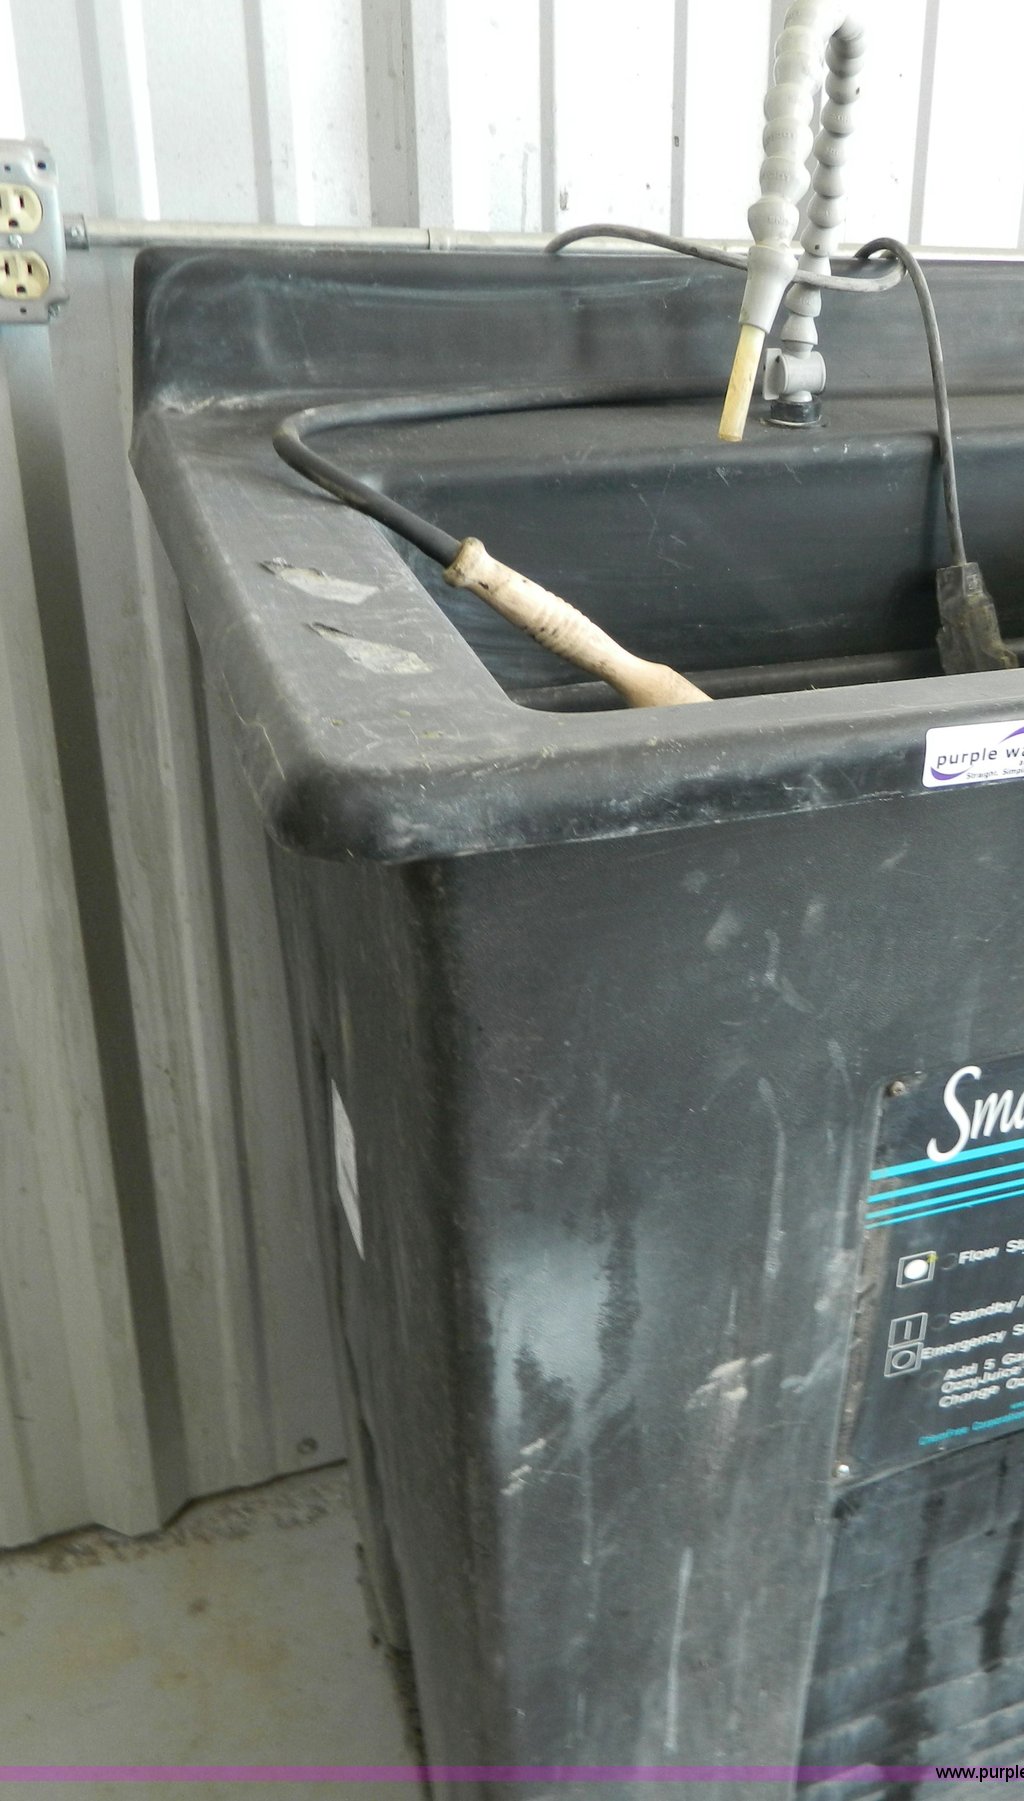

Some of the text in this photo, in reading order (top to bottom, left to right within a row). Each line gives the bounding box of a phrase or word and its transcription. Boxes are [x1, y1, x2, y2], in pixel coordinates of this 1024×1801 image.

[936, 747, 998, 769] purple
[958, 1247, 1000, 1265] Flow
[920, 1330, 1007, 1360] Emergency
[943, 1363, 979, 1381] Add
[983, 1358, 996, 1371] 5
[938, 1385, 1001, 1409] Change
